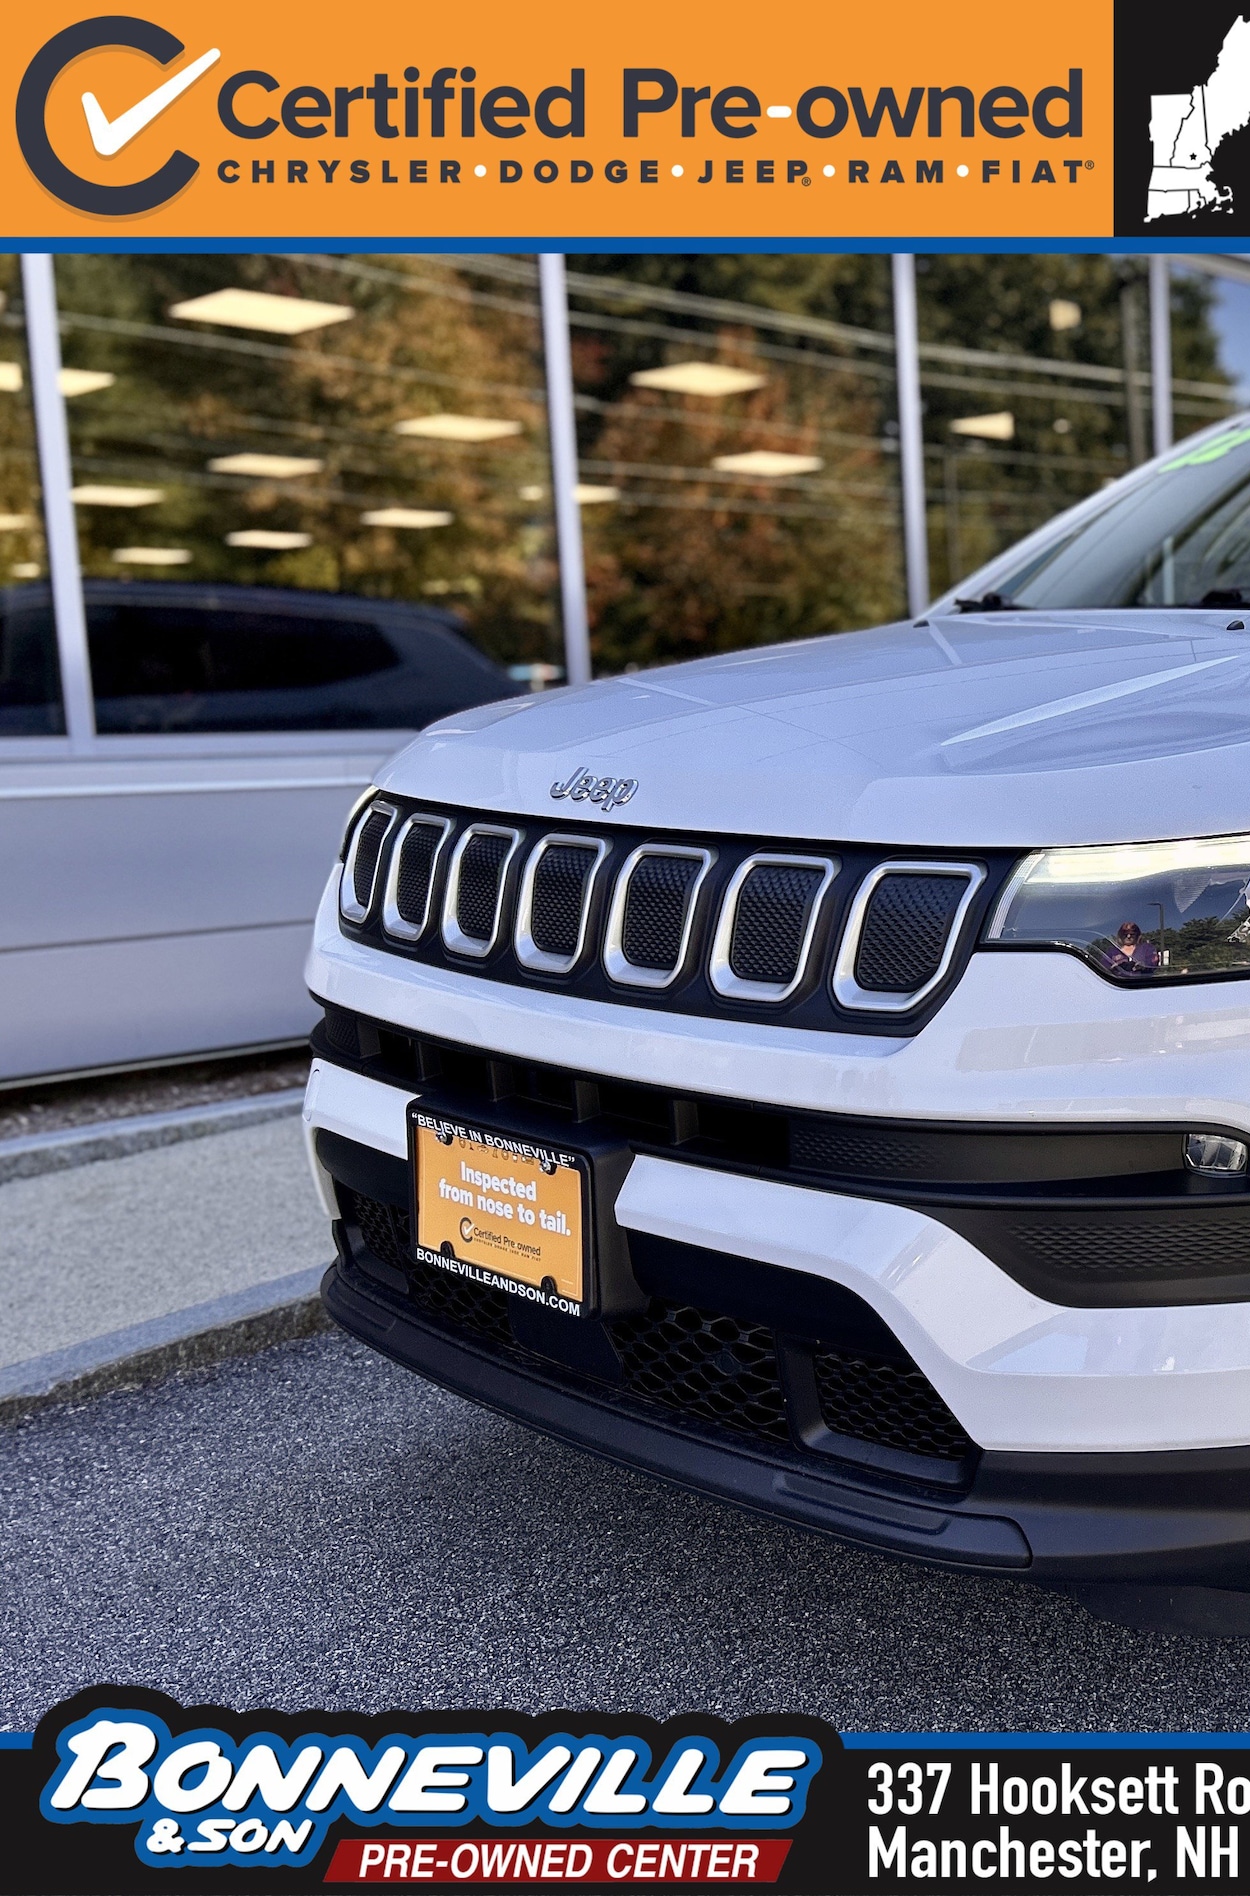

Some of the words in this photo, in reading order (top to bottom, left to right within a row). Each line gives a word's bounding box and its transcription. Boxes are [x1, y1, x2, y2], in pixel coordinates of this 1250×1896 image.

[549, 766, 640, 812] Jeep
[469, 1129, 483, 1143] IN
[460, 1160, 537, 1202] Inspected
[439, 1178, 474, 1207] from
[477, 1194, 514, 1220] nose
[517, 1203, 536, 1226] to
[539, 1209, 571, 1236] tail.
[473, 1227, 502, 1244] Certified
[416, 1247, 581, 1317] BONNEVILLEANDSON.COM
